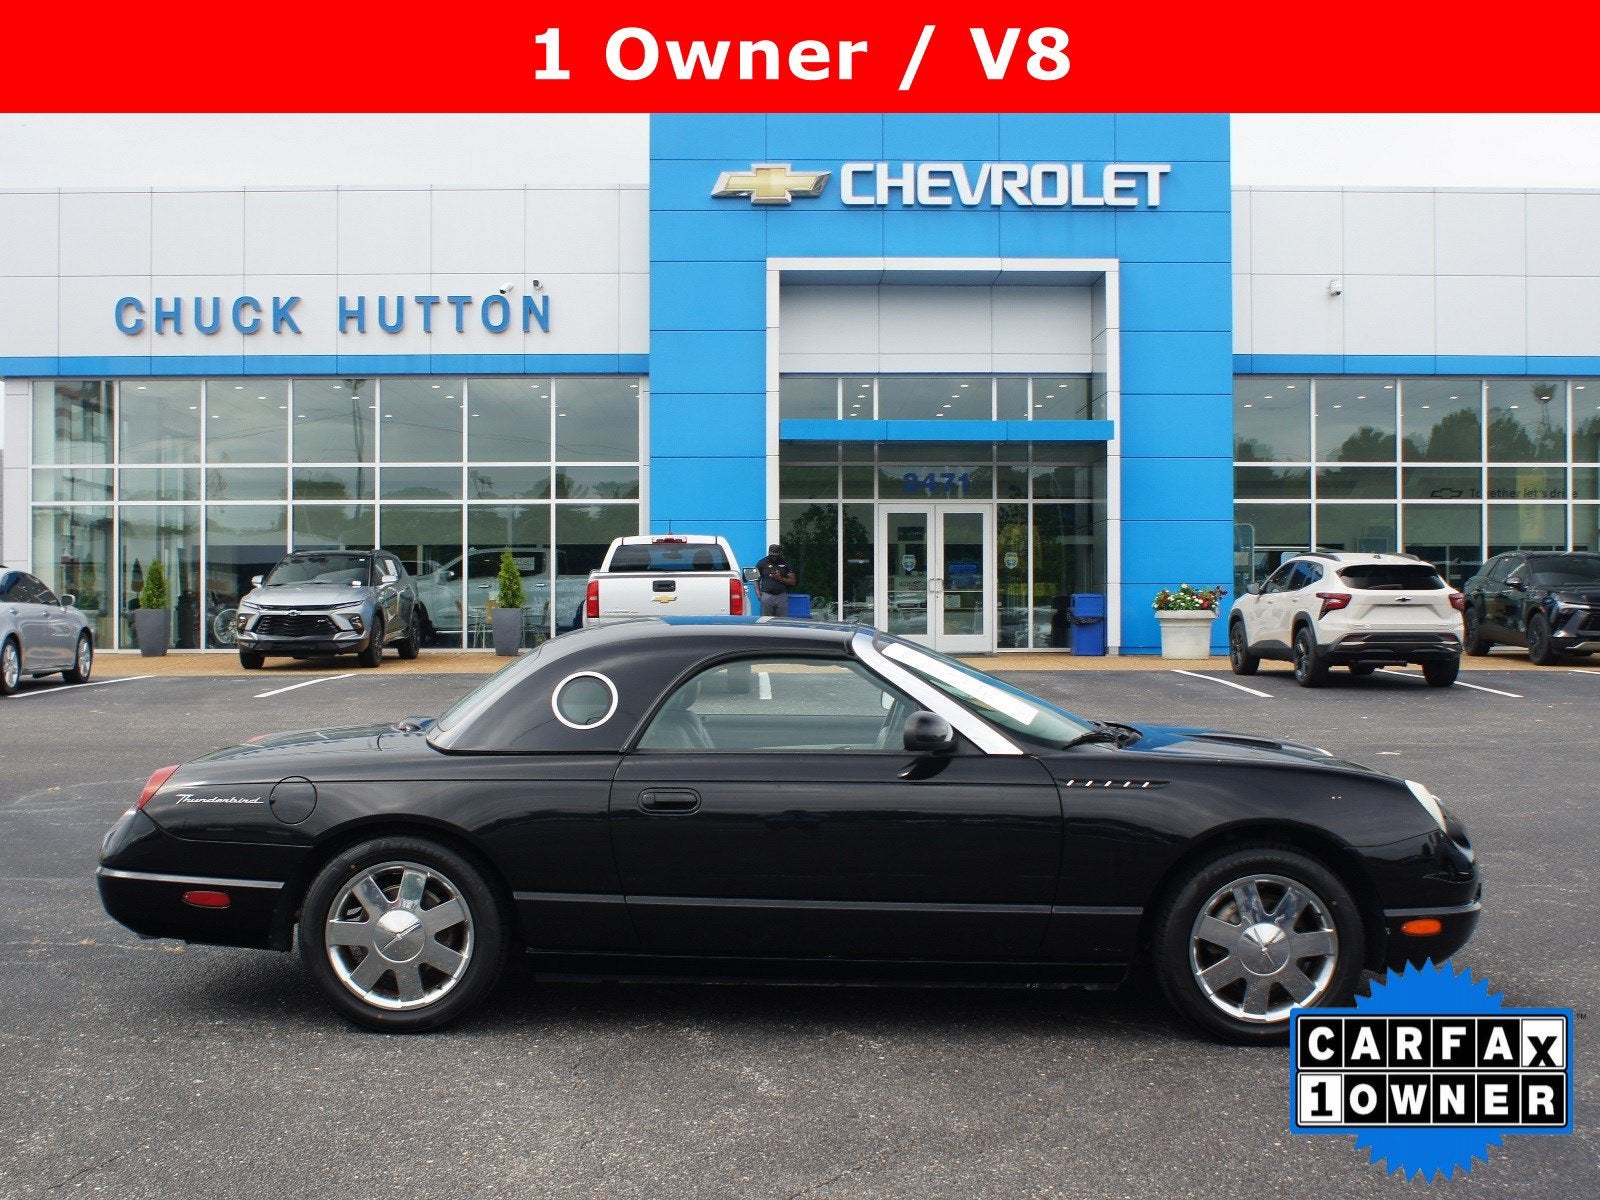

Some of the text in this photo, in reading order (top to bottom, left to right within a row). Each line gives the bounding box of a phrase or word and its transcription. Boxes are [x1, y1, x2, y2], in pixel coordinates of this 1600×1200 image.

[840, 162, 1172, 207] CHEVROLET
[114, 294, 551, 335] CHUCK HUTTON
[1470, 488, 1520, 498] Toether
[1550, 488, 1577, 499] drie
[176, 794, 264, 805] Thunderbird
